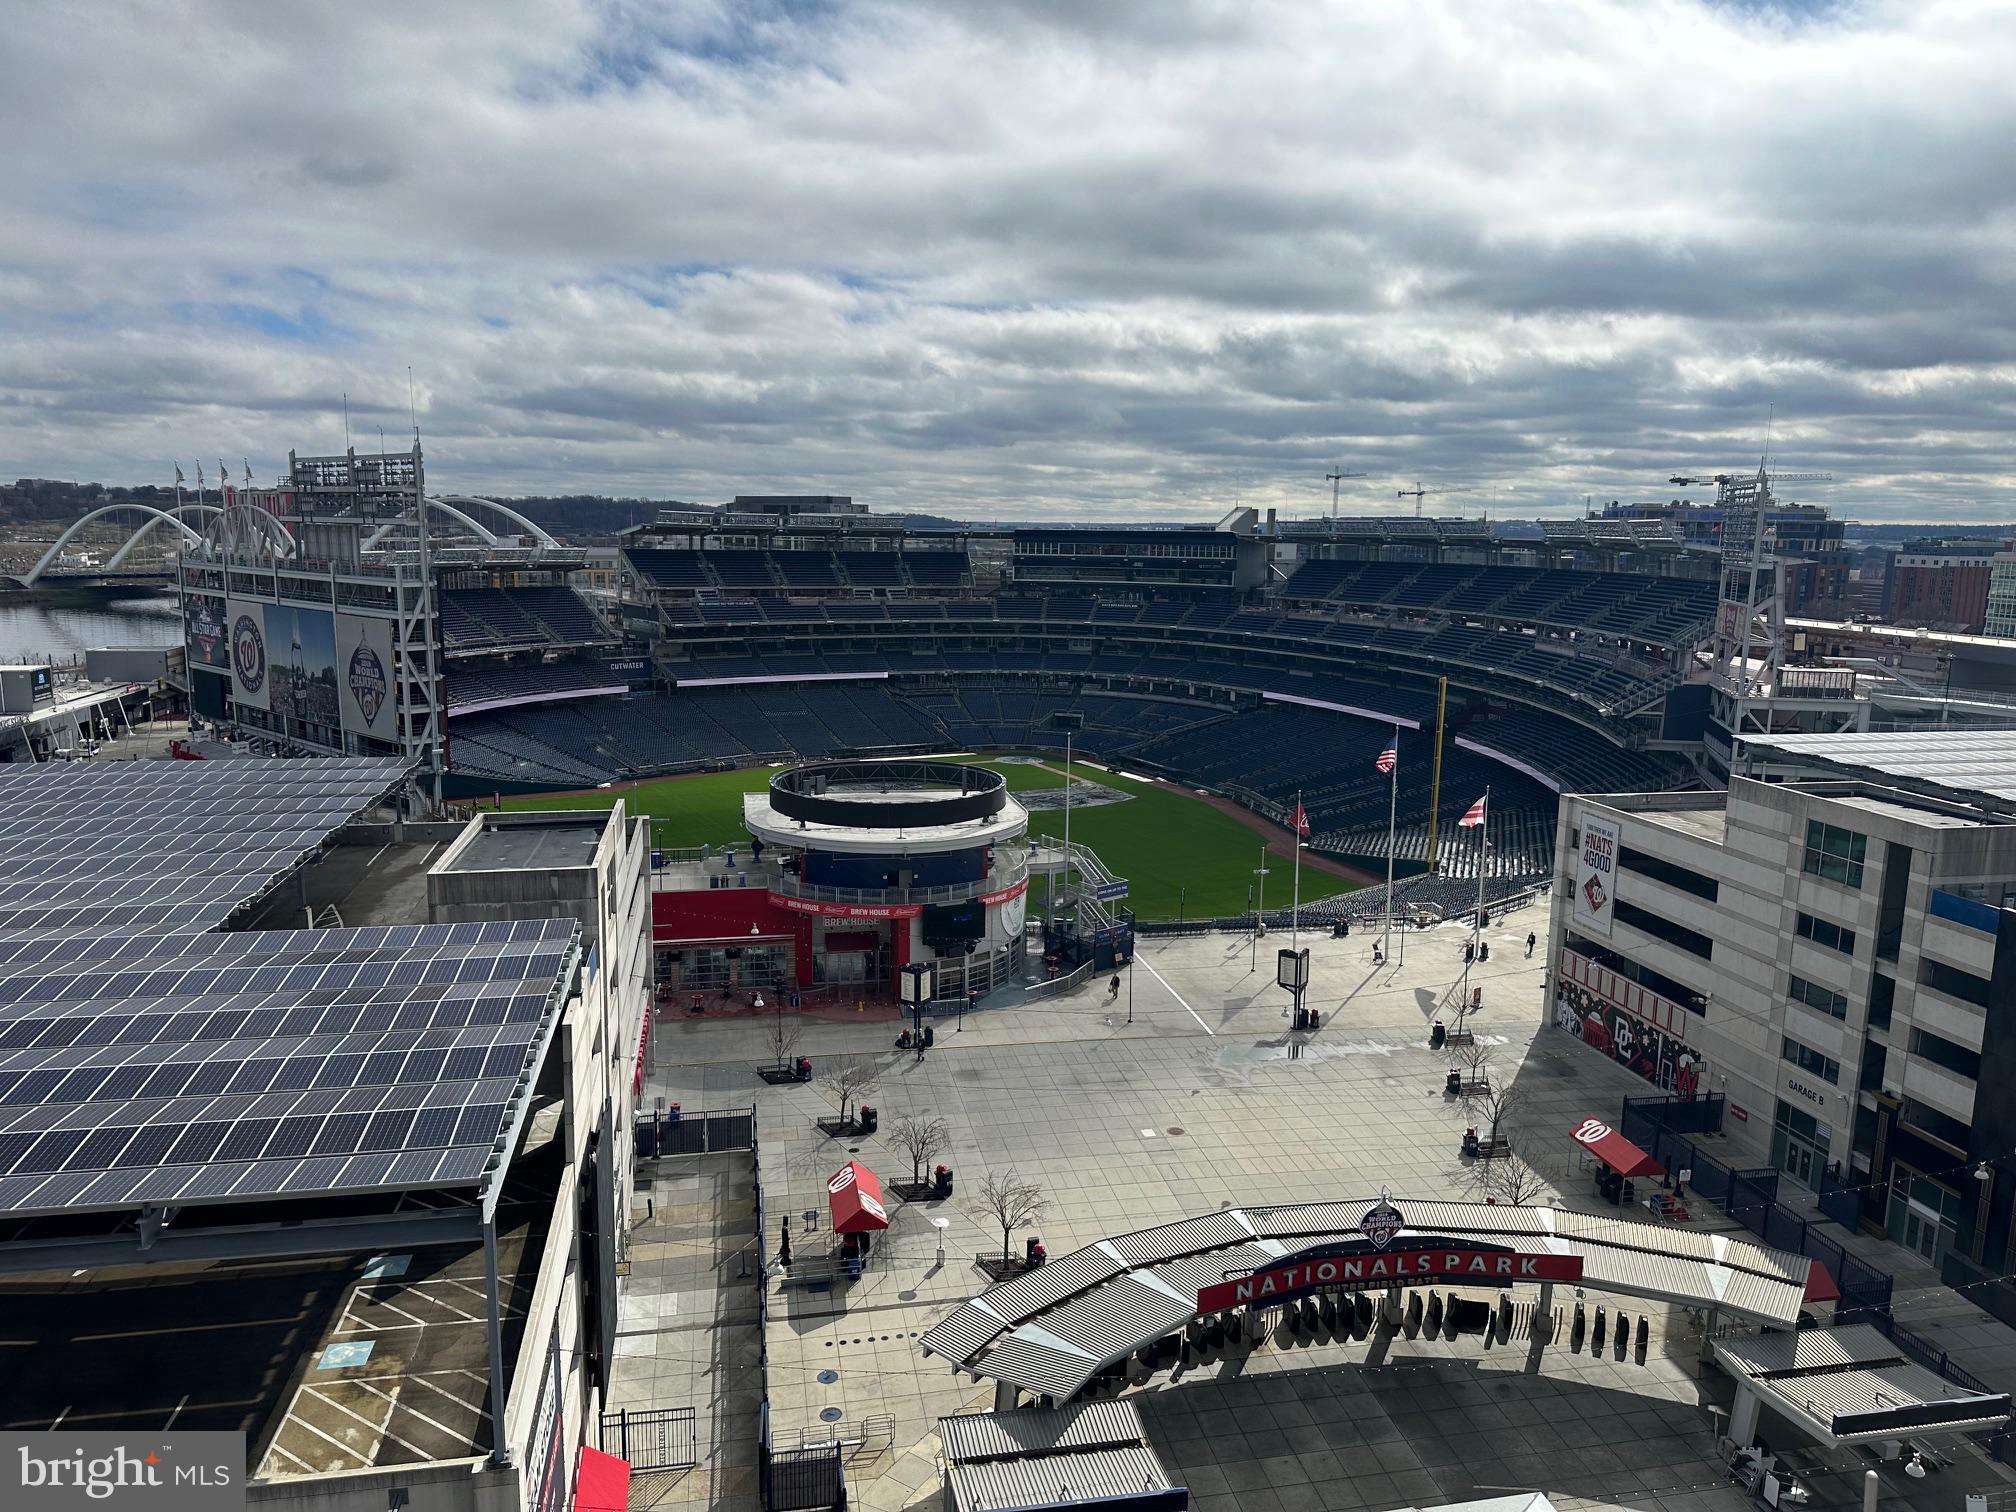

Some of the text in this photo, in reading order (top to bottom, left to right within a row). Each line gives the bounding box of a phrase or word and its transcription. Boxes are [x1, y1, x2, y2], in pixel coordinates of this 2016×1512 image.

[355, 664, 379, 678] WORLD
[610, 662, 644, 670] CUTWATER
[349, 674, 386, 694] CHAMPIONS
[1584, 832, 1613, 856] #NATS
[1583, 850, 1611, 873] 4GOOD
[801, 903, 820, 911] HOUSE
[850, 908, 868, 916] BREW
[869, 908, 890, 916] HOUSE
[824, 917, 880, 927] BREW HOUSE
[1788, 1079, 1824, 1105] GARAGE B
[1361, 1220, 1403, 1230] CHAMPIONS
[1369, 1215, 1396, 1223] WORLD
[1235, 1252, 1540, 1302] NATIONALS PARK
[1315, 1276, 1440, 1294] CENTER FIELD GATE
